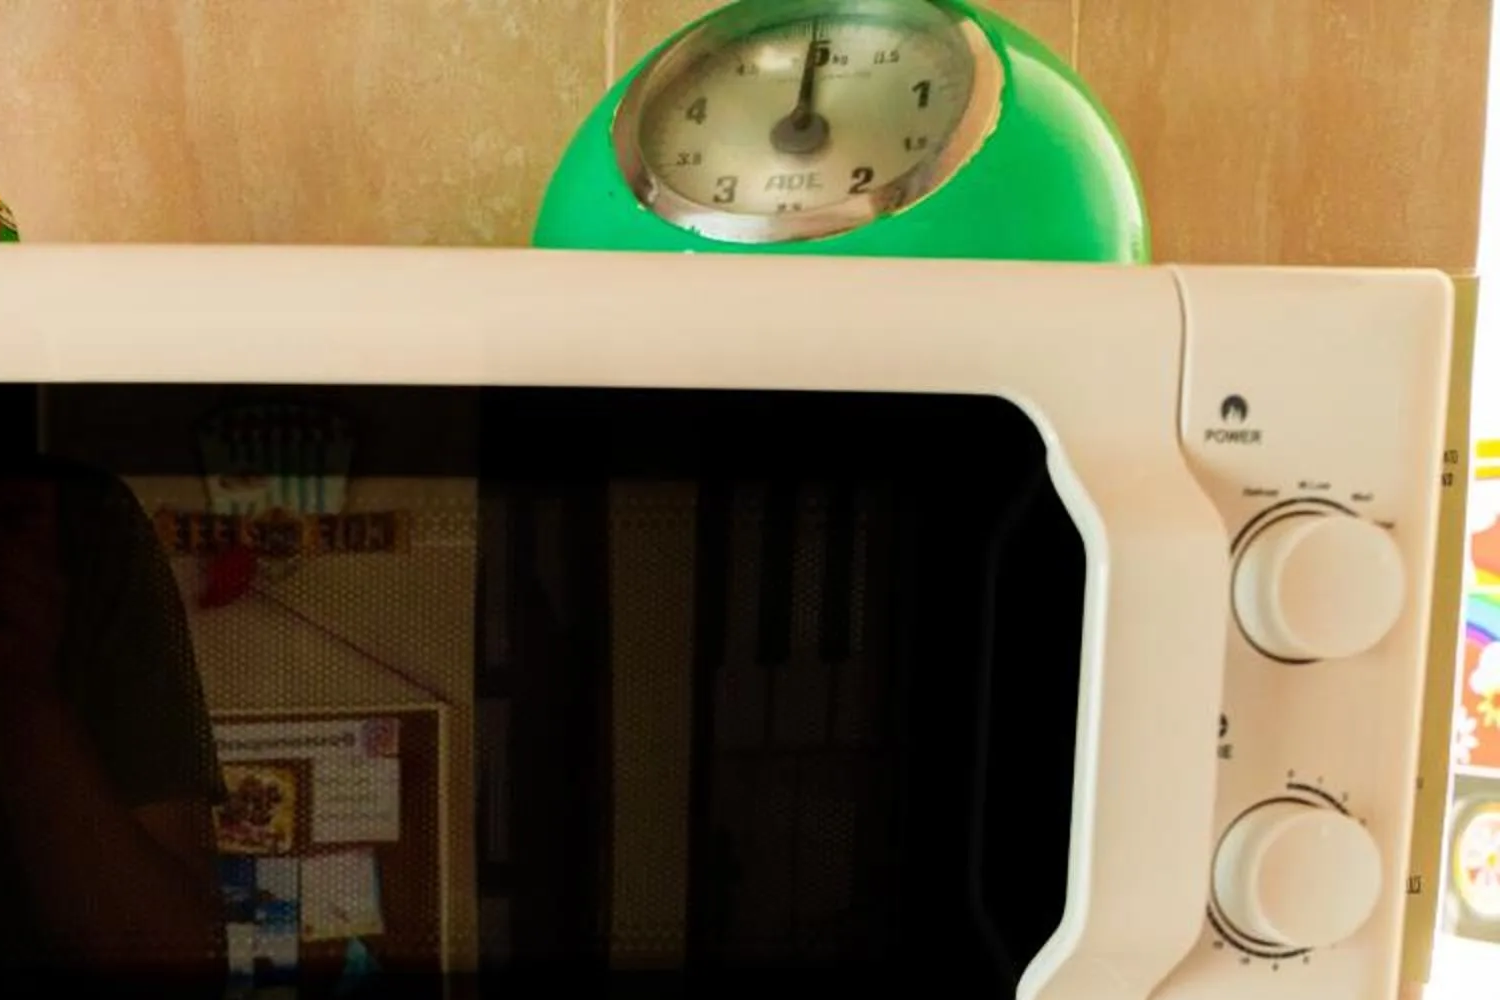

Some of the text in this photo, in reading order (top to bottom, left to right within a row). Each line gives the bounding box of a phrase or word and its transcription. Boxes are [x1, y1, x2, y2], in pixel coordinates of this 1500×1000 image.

[912, 80, 931, 108] 1
[685, 97, 707, 125] 4
[713, 175, 738, 204] 3
[765, 170, 824, 191] ADE
[848, 166, 874, 195] 2
[1203, 429, 1263, 445] POWER
